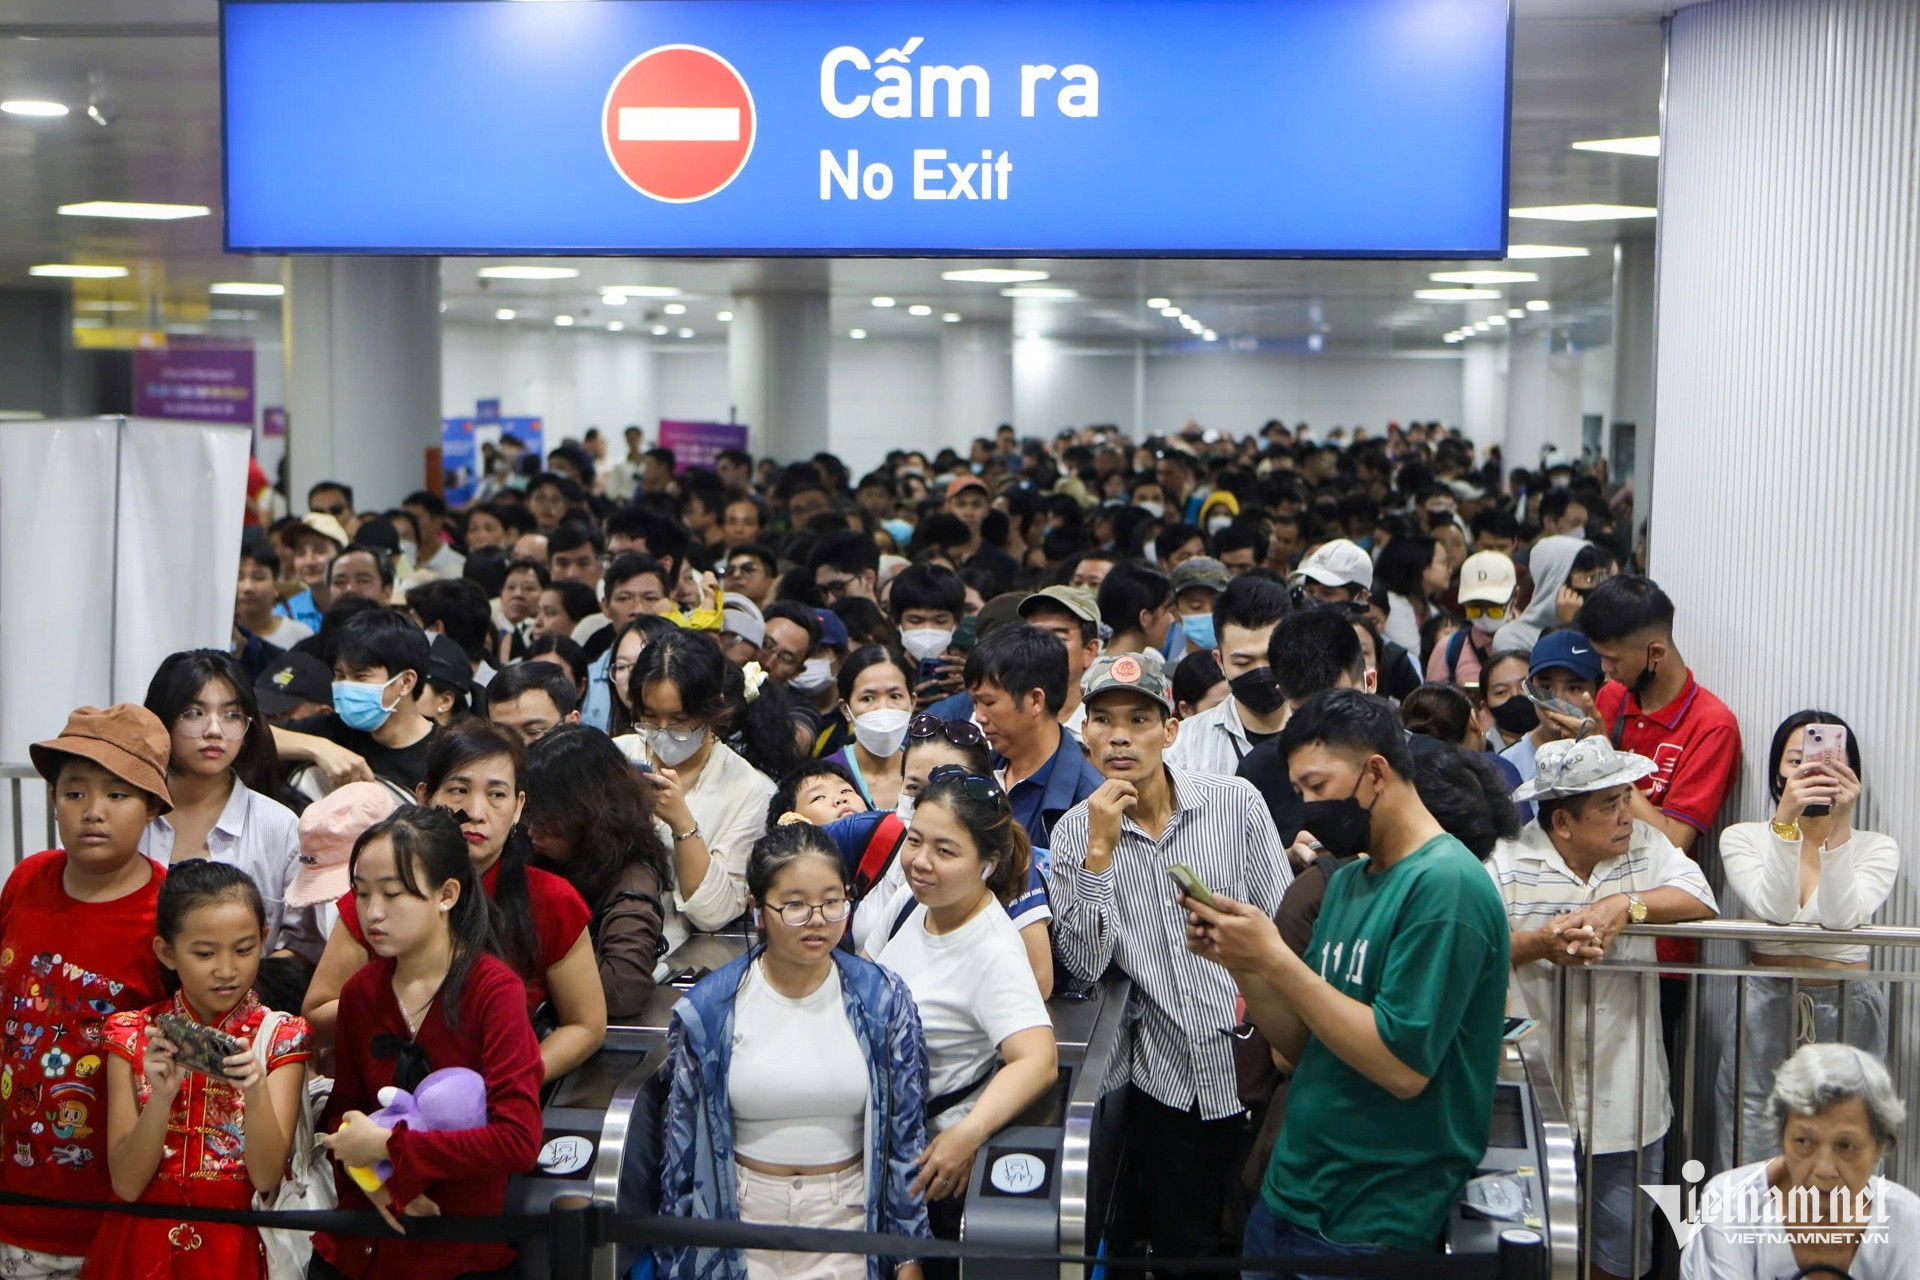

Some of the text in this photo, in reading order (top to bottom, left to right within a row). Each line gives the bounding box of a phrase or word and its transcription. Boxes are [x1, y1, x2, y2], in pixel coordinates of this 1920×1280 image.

[820, 37, 1099, 119] Cấm ra
[820, 149, 1013, 200] No Exit
[1478, 570, 1487, 581] D
